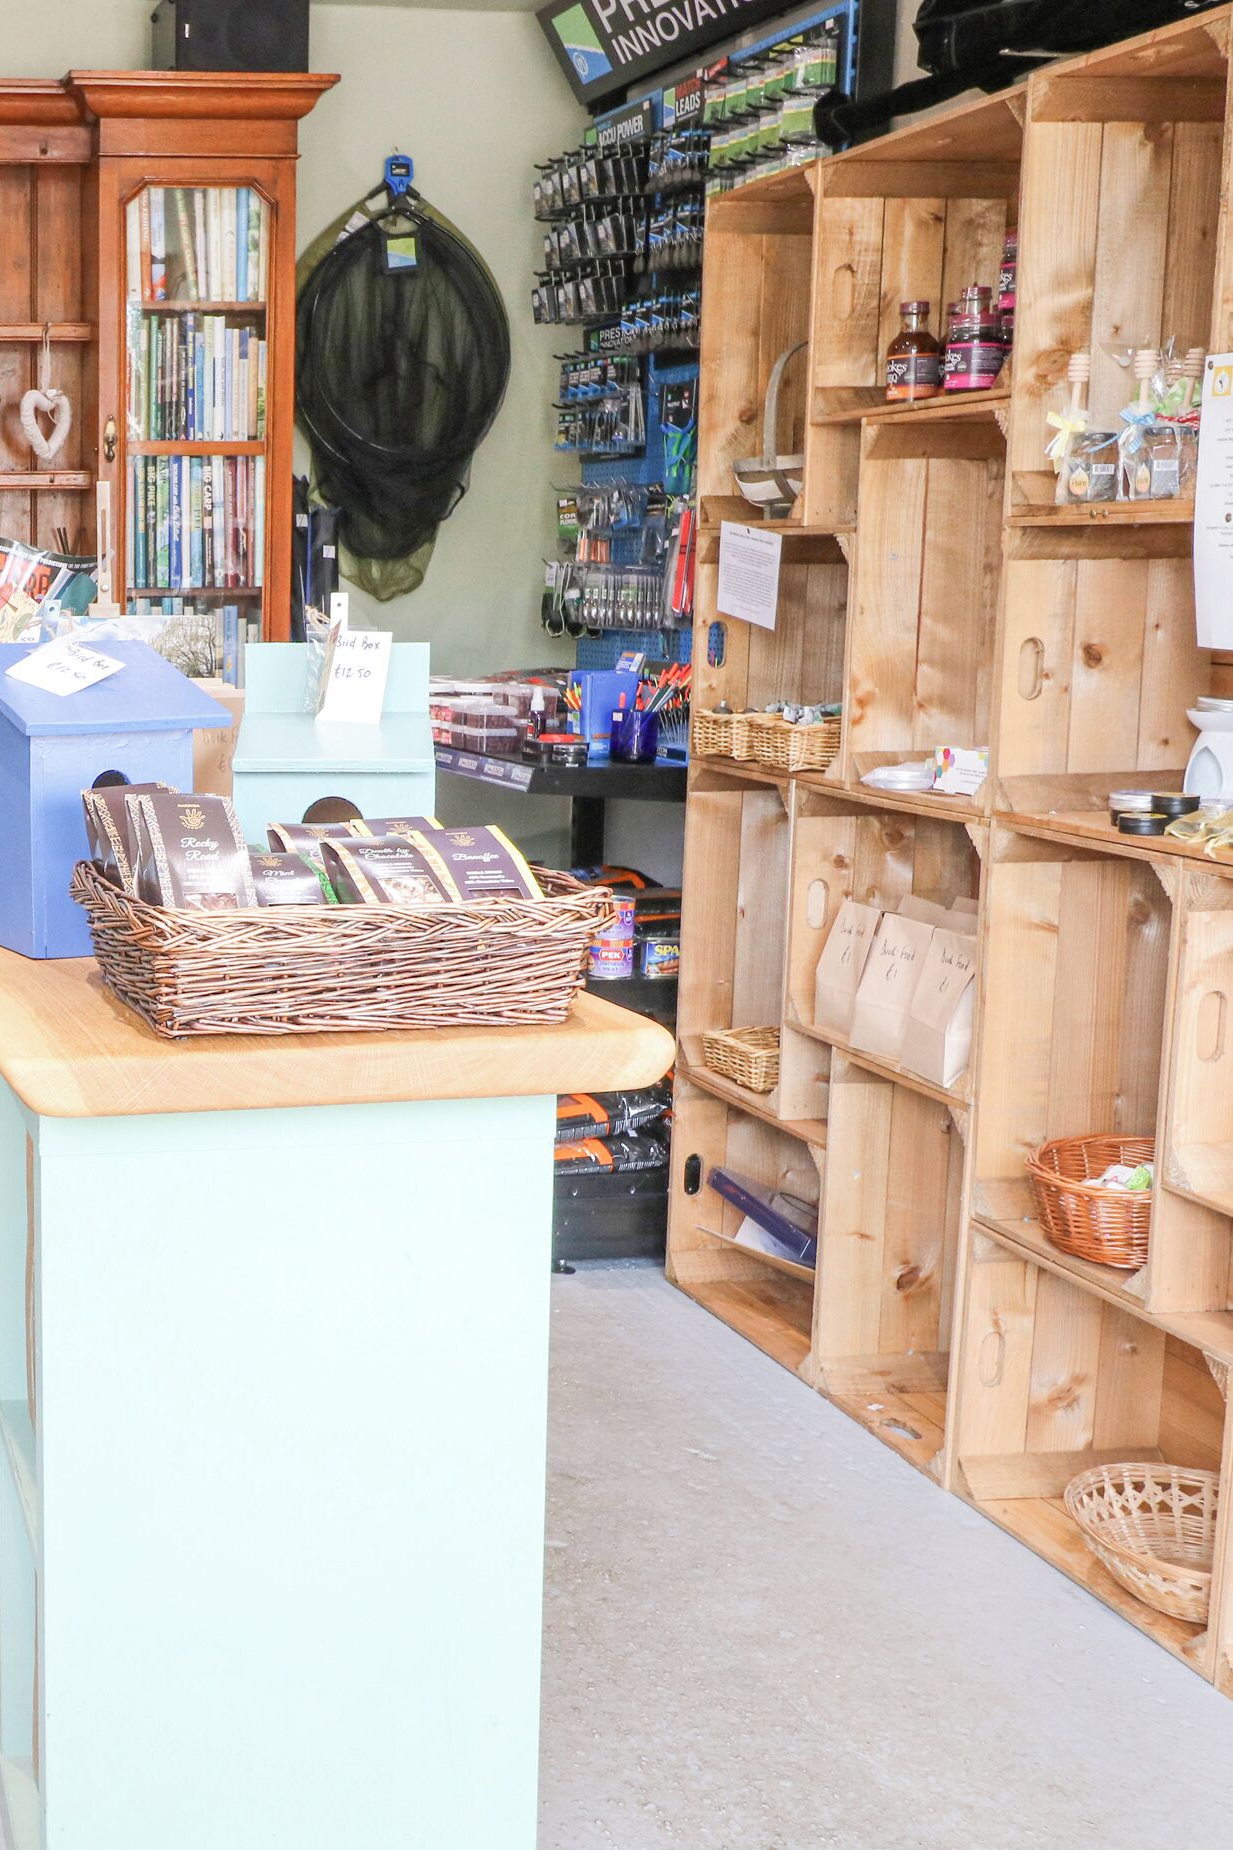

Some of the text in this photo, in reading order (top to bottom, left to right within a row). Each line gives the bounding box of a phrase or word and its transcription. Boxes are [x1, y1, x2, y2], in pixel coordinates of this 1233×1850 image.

[675, 91, 701, 117] LEADS
[598, 126, 617, 146] ACCU
[617, 115, 643, 139] POWER
[147, 466, 156, 506] BIG PIKE
[203, 466, 212, 511] BIG CARP
[334, 634, 381, 650] Bird Box
[180, 837, 220, 851] Rocky
[185, 850, 220, 861] Road
[364, 852, 415, 860] Chocolate
[396, 847, 411, 856] by
[451, 852, 499, 862] Banoffee
[601, 951, 621, 959] PEK
[653, 944, 680, 957] SPA
